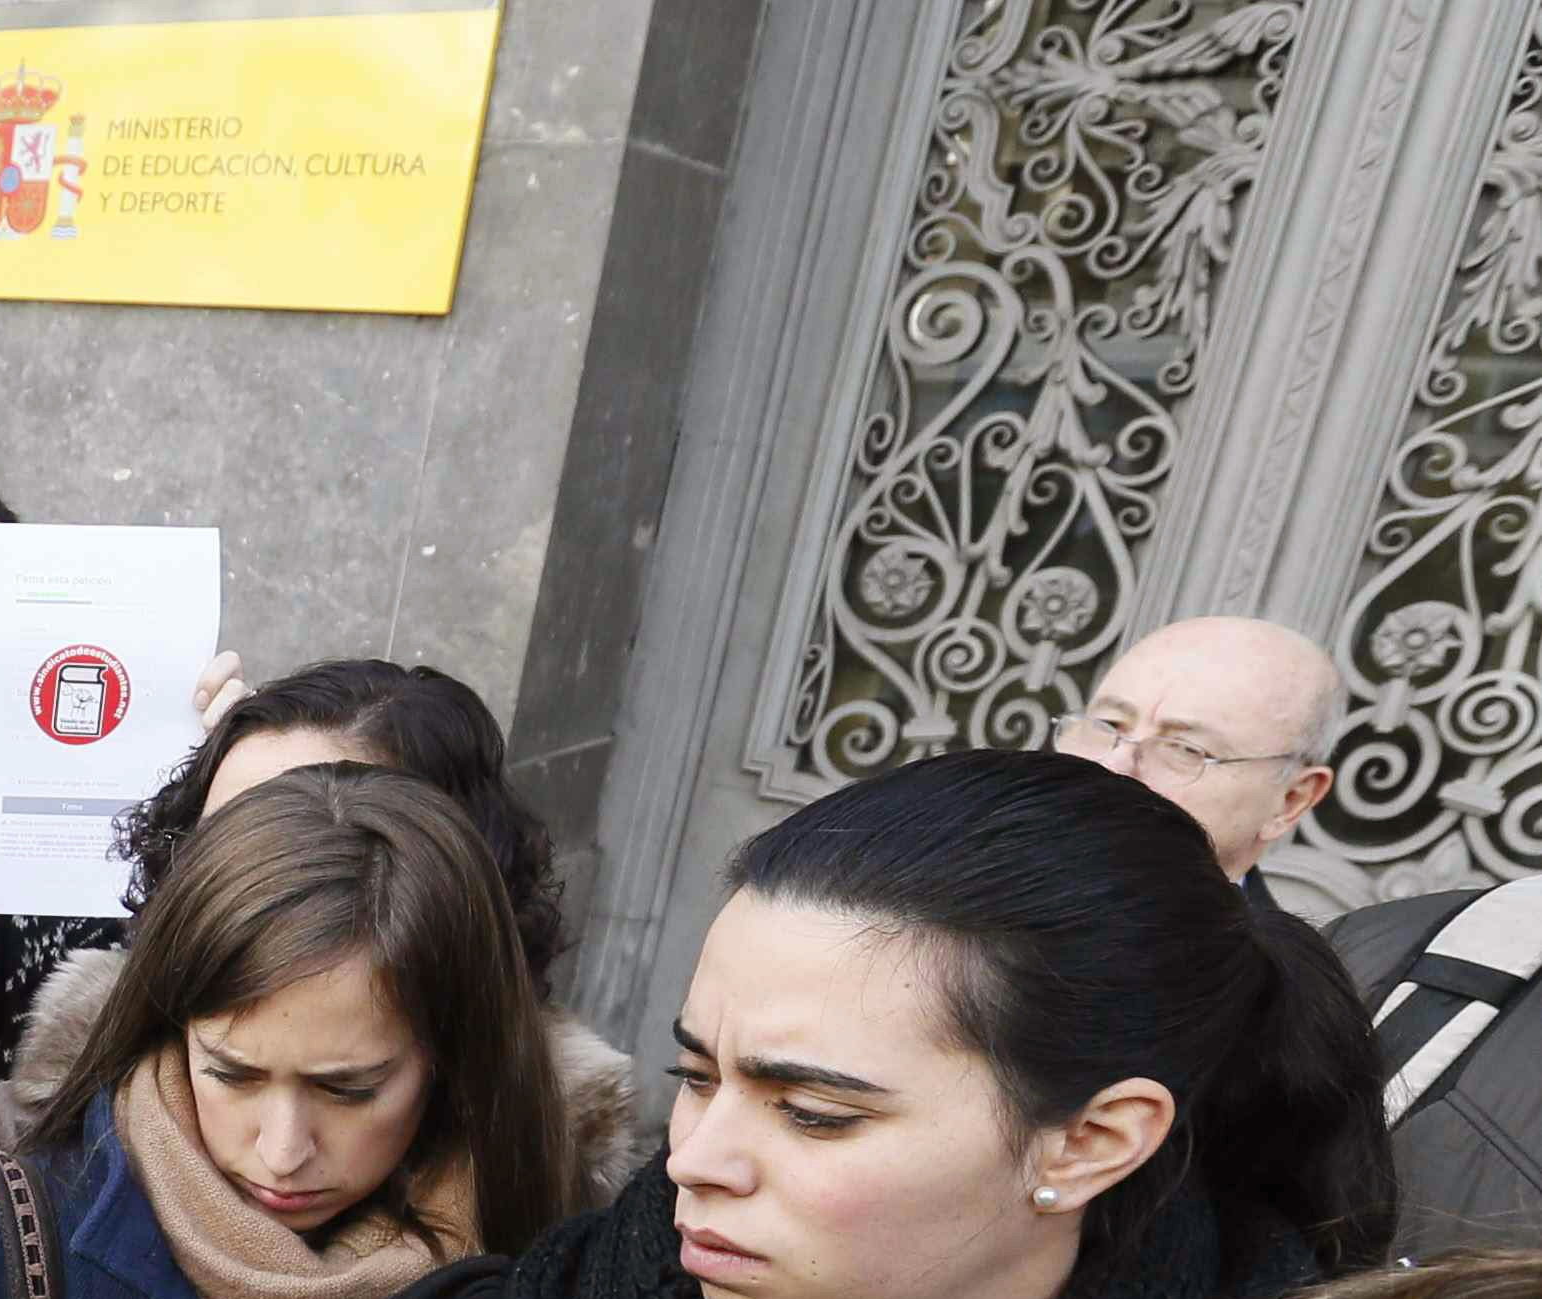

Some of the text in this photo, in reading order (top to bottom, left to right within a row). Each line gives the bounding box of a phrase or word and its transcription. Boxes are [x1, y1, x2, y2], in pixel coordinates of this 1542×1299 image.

[107, 116, 242, 140] MINISTERIO
[102, 149, 426, 176] DE EDUCACIÓN, CULTURA
[99, 191, 226, 214] Y DEPORTE
